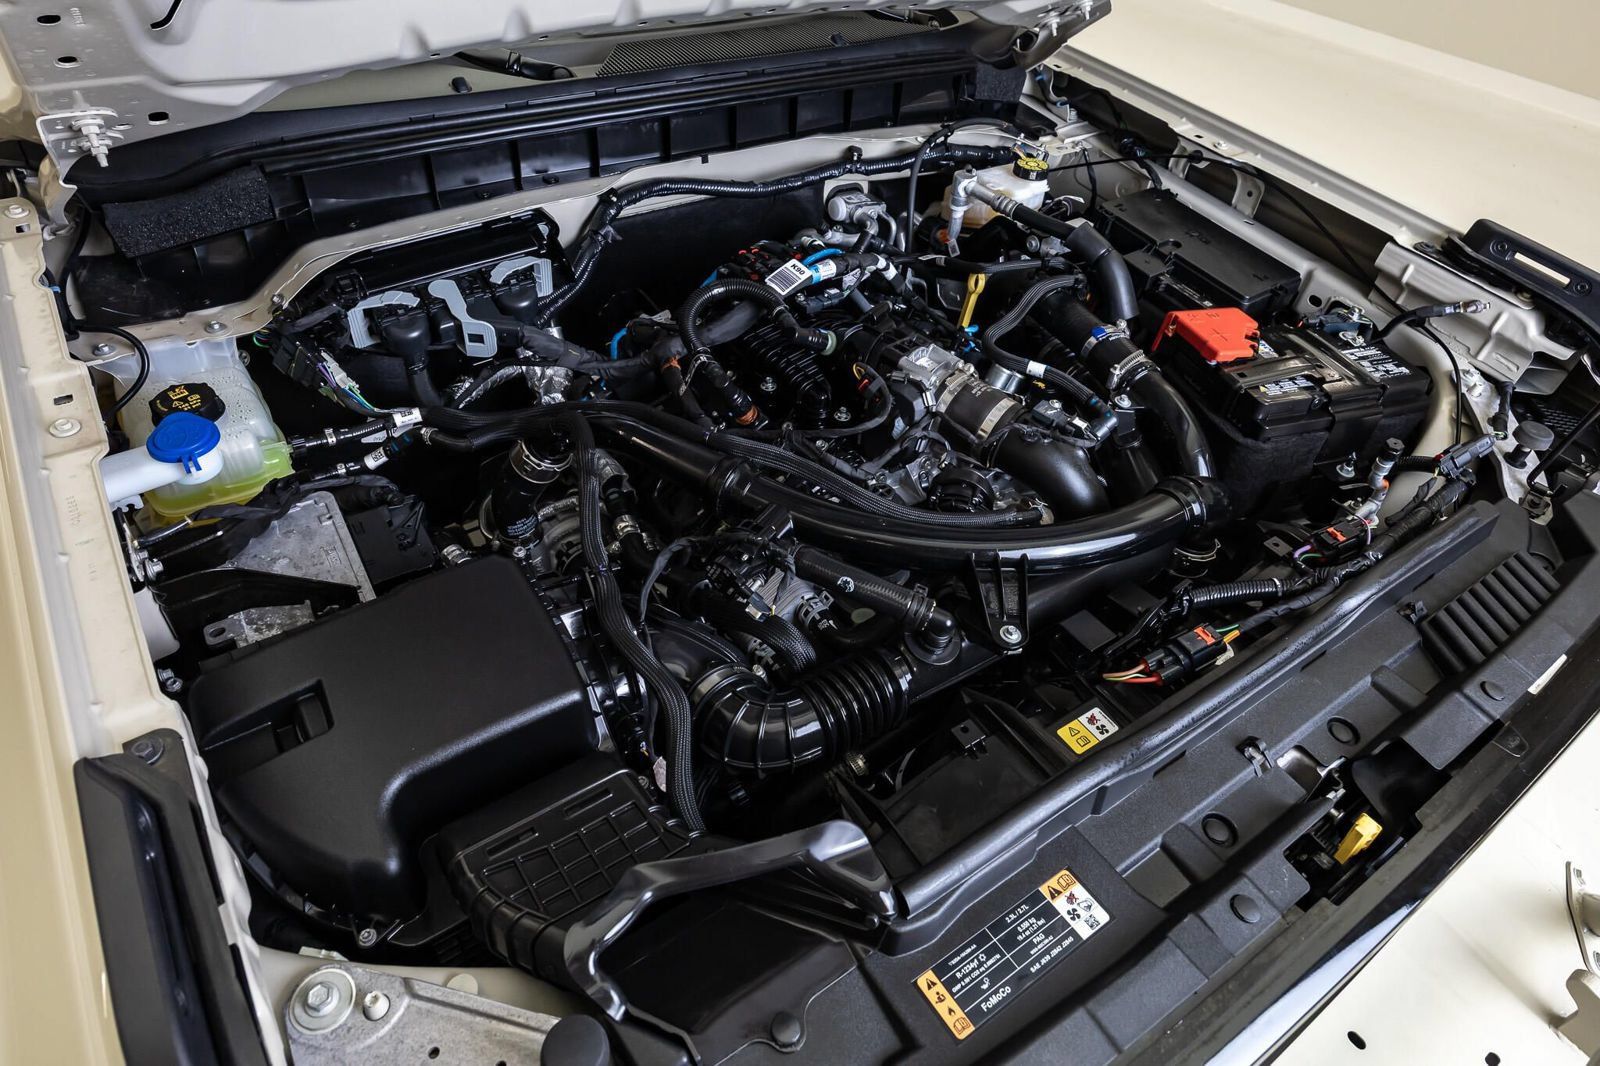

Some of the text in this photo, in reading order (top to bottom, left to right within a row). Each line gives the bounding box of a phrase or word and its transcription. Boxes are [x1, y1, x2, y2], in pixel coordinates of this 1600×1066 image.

[790, 264, 806, 276] K90
[1005, 913, 1016, 922] 2.3L
[1017, 904, 1028, 913] 2.7L
[1032, 933, 1045, 944] PAG
[955, 959, 979, 979] R-1234yf
[1029, 962, 1040, 972] SAE
[980, 984, 1011, 1012] FoMoCo
